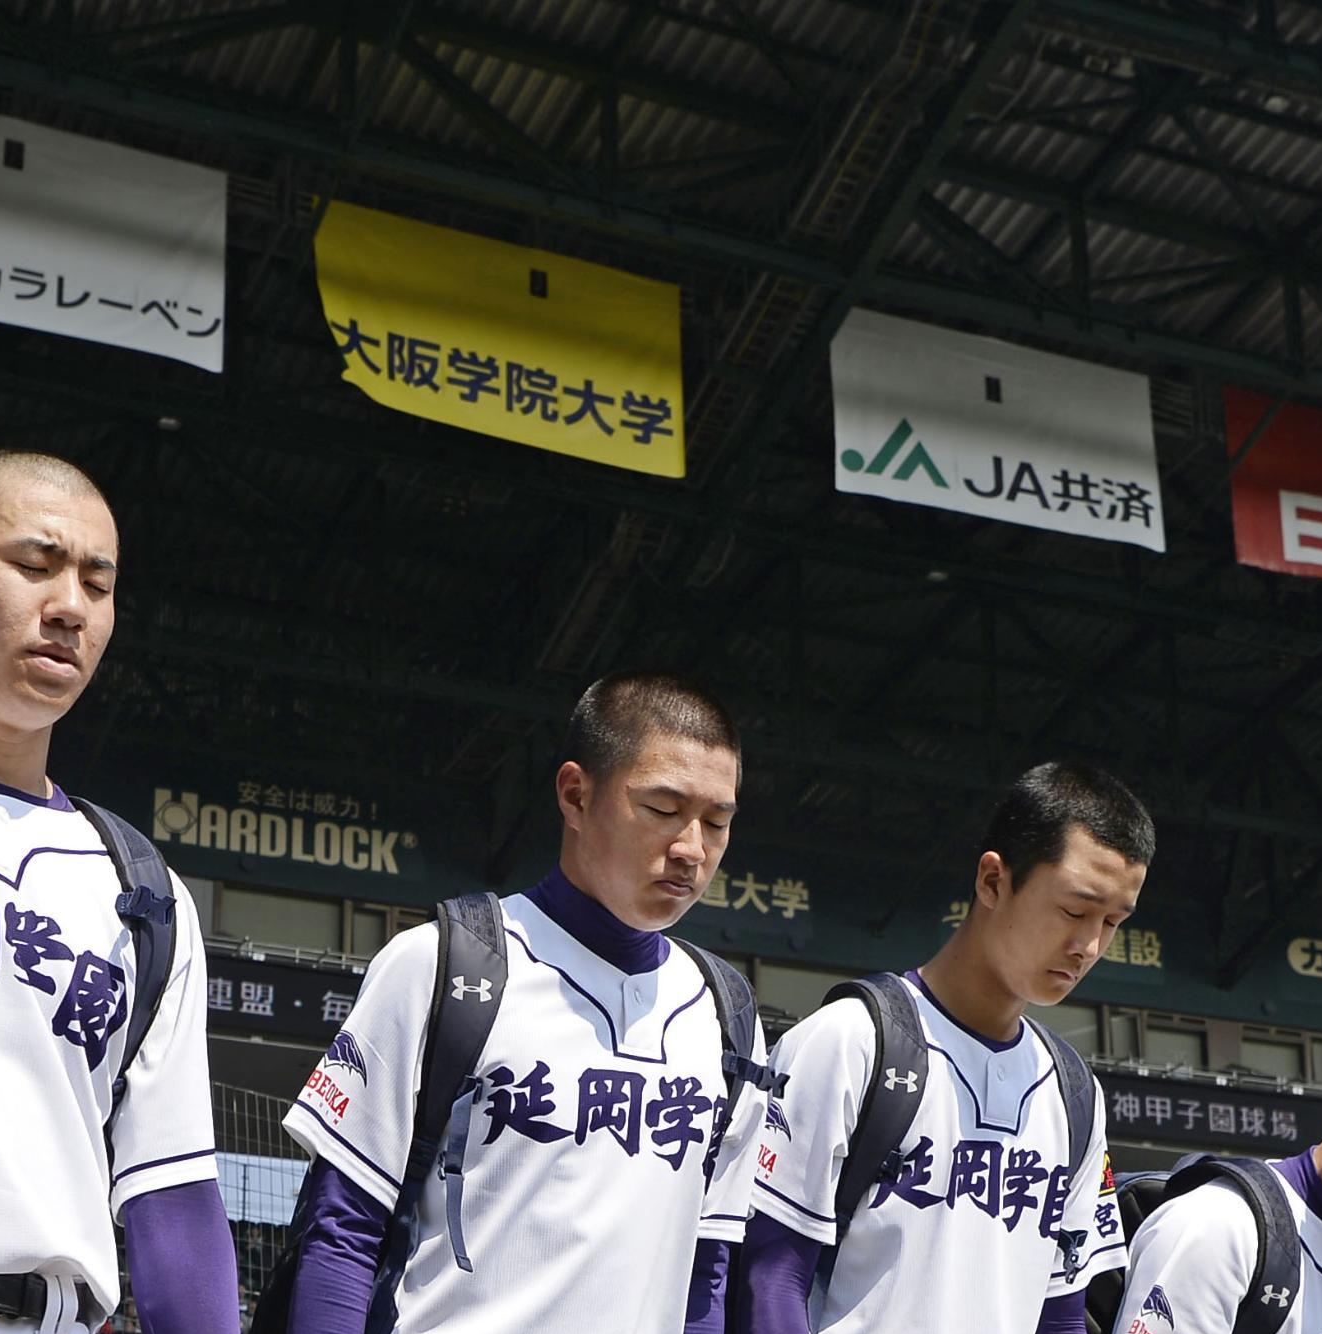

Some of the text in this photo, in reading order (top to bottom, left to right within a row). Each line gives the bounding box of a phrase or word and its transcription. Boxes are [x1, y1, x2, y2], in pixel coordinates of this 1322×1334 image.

[329, 318, 675, 447] 大阪学院大学
[963, 456, 1156, 530] JA共済
